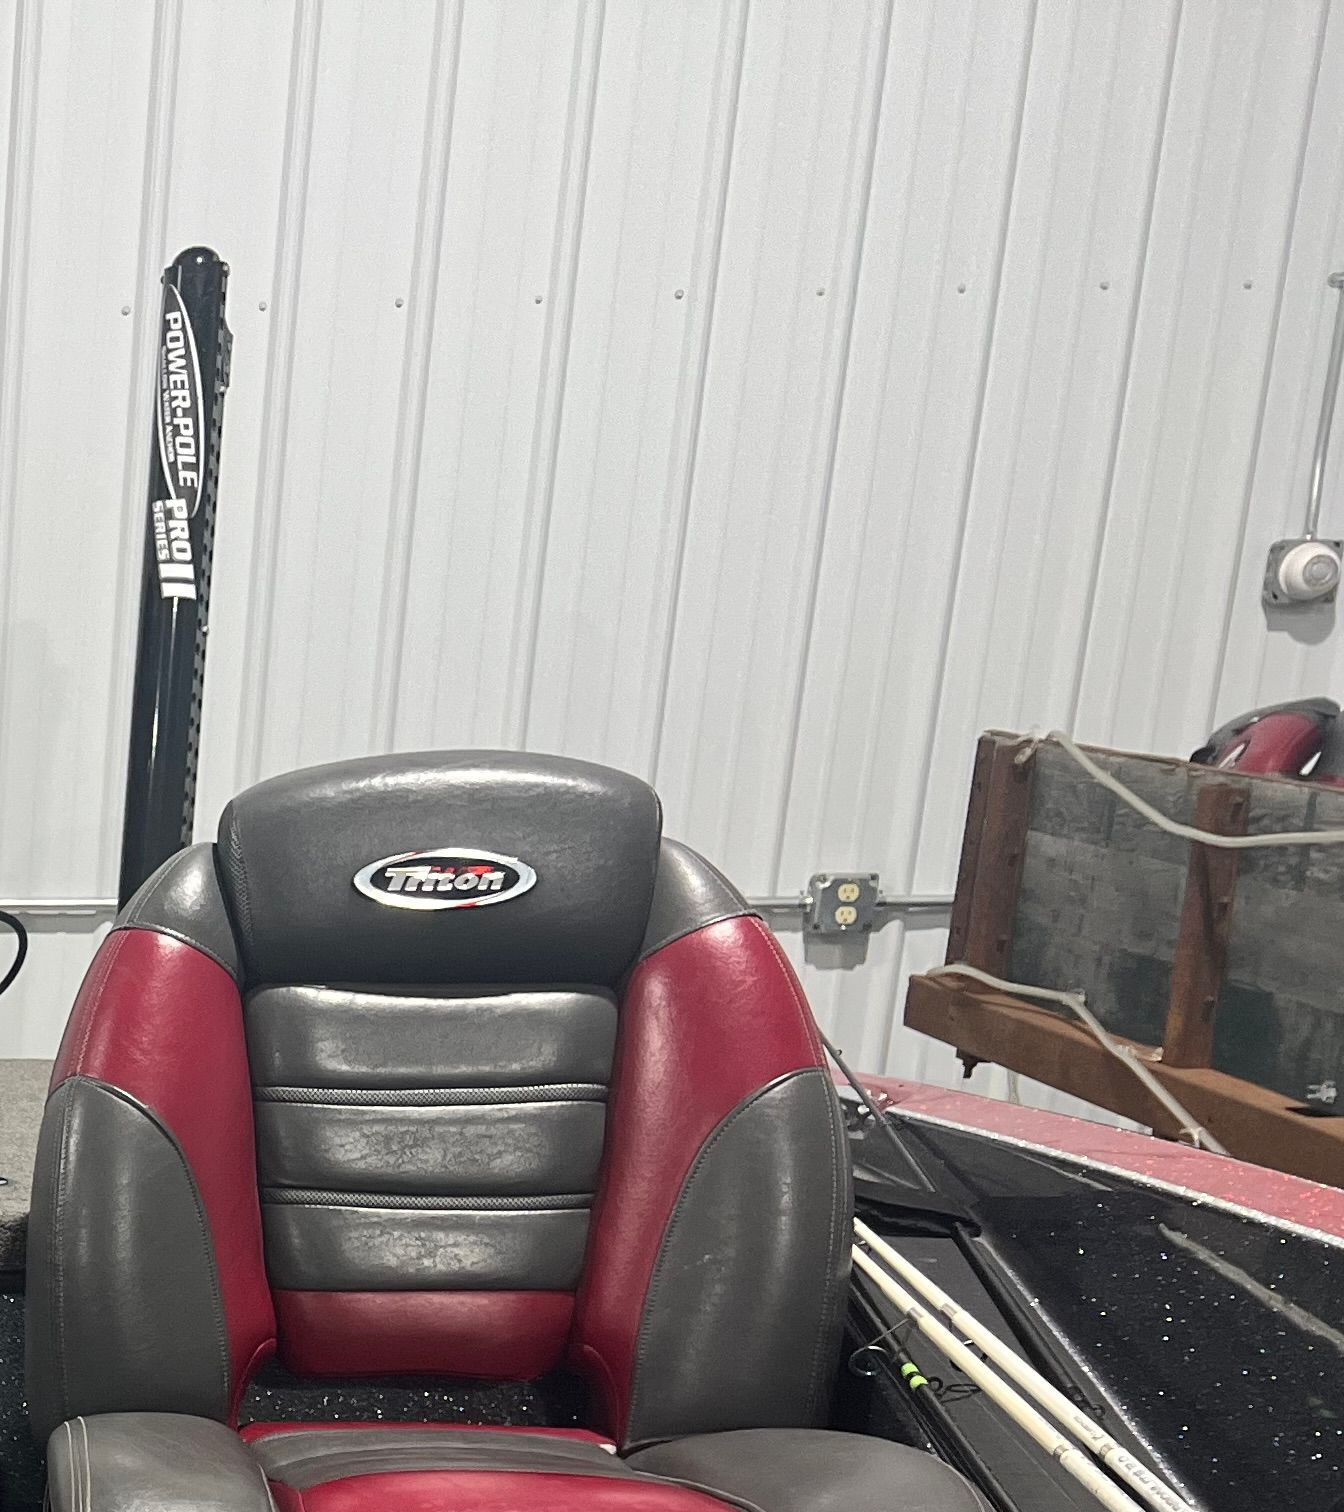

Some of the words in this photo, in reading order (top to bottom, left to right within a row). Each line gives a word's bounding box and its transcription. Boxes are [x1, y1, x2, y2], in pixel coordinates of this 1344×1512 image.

[165, 311, 198, 488] POWER-POLE
[152, 500, 170, 561] SERIES
[165, 498, 192, 561] PRO
[384, 865, 506, 892] Triton
